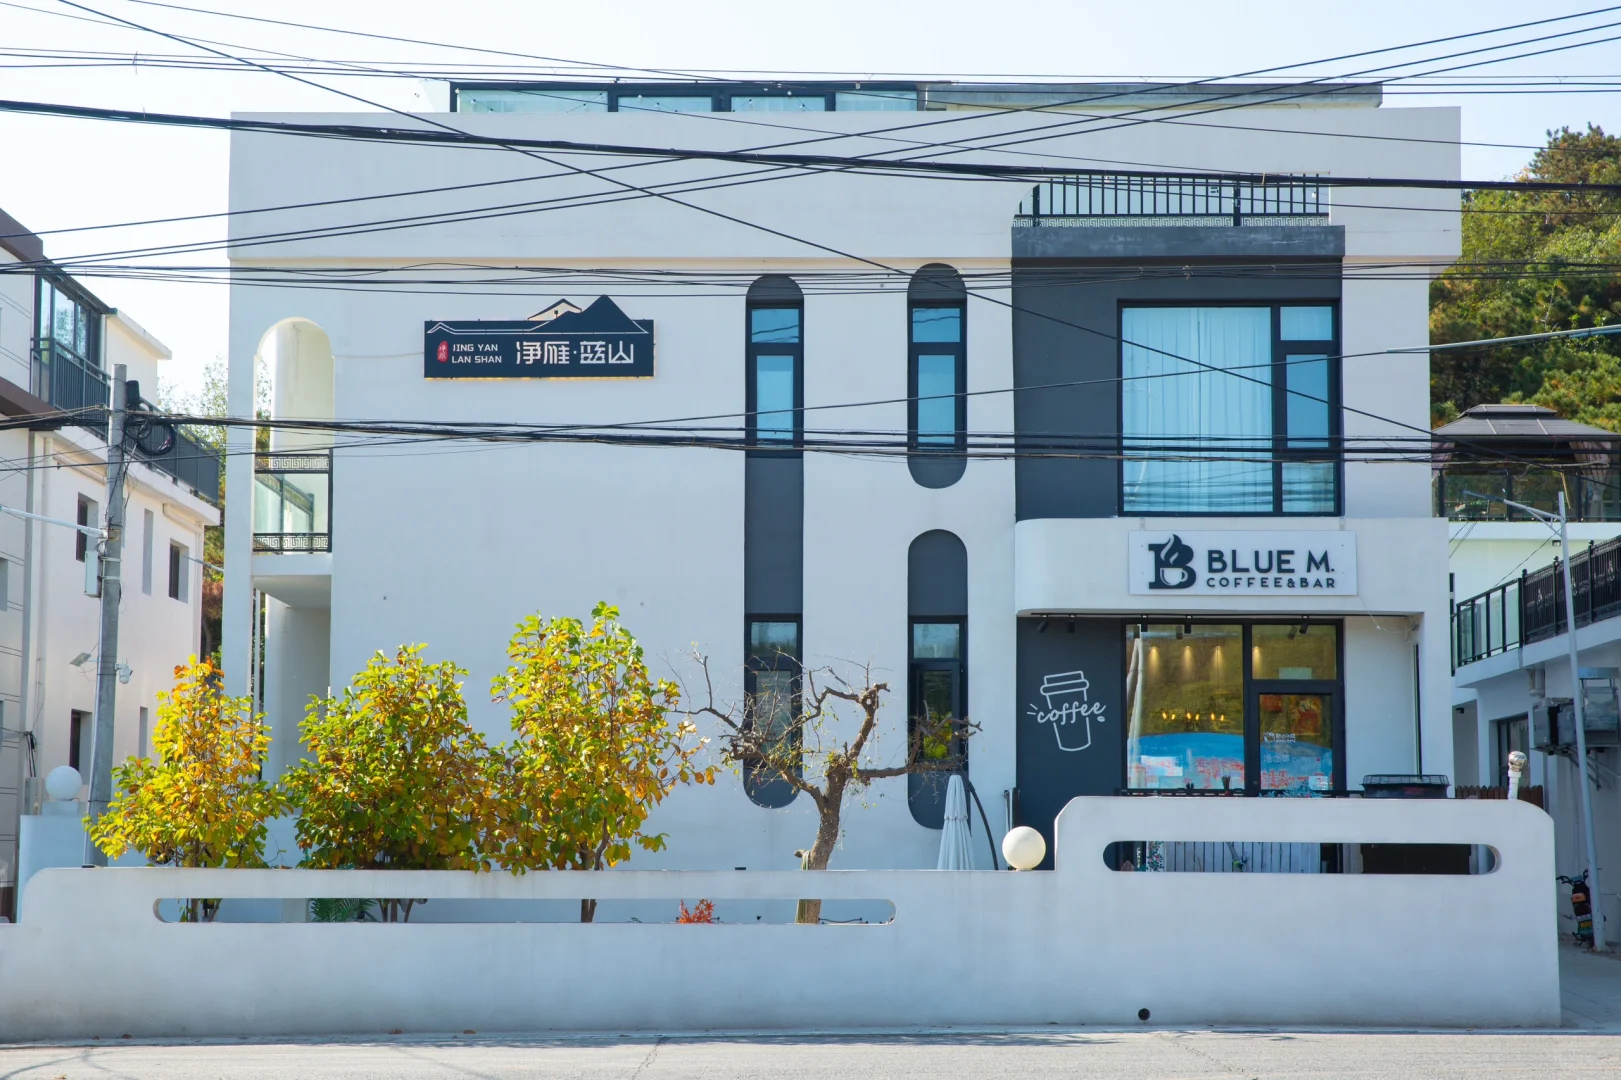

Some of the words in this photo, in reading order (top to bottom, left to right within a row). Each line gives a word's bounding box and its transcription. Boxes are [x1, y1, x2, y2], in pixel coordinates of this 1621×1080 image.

[452, 343, 474, 352] JING
[477, 343, 498, 352] YAN
[451, 355, 471, 364] LAN
[474, 355, 502, 364] SHAN
[1207, 549, 1295, 574] BLUE
[1306, 549, 1335, 573] M.
[1206, 577, 1336, 588] COFFEE&BAR
[1037, 701, 1106, 725] coffee
